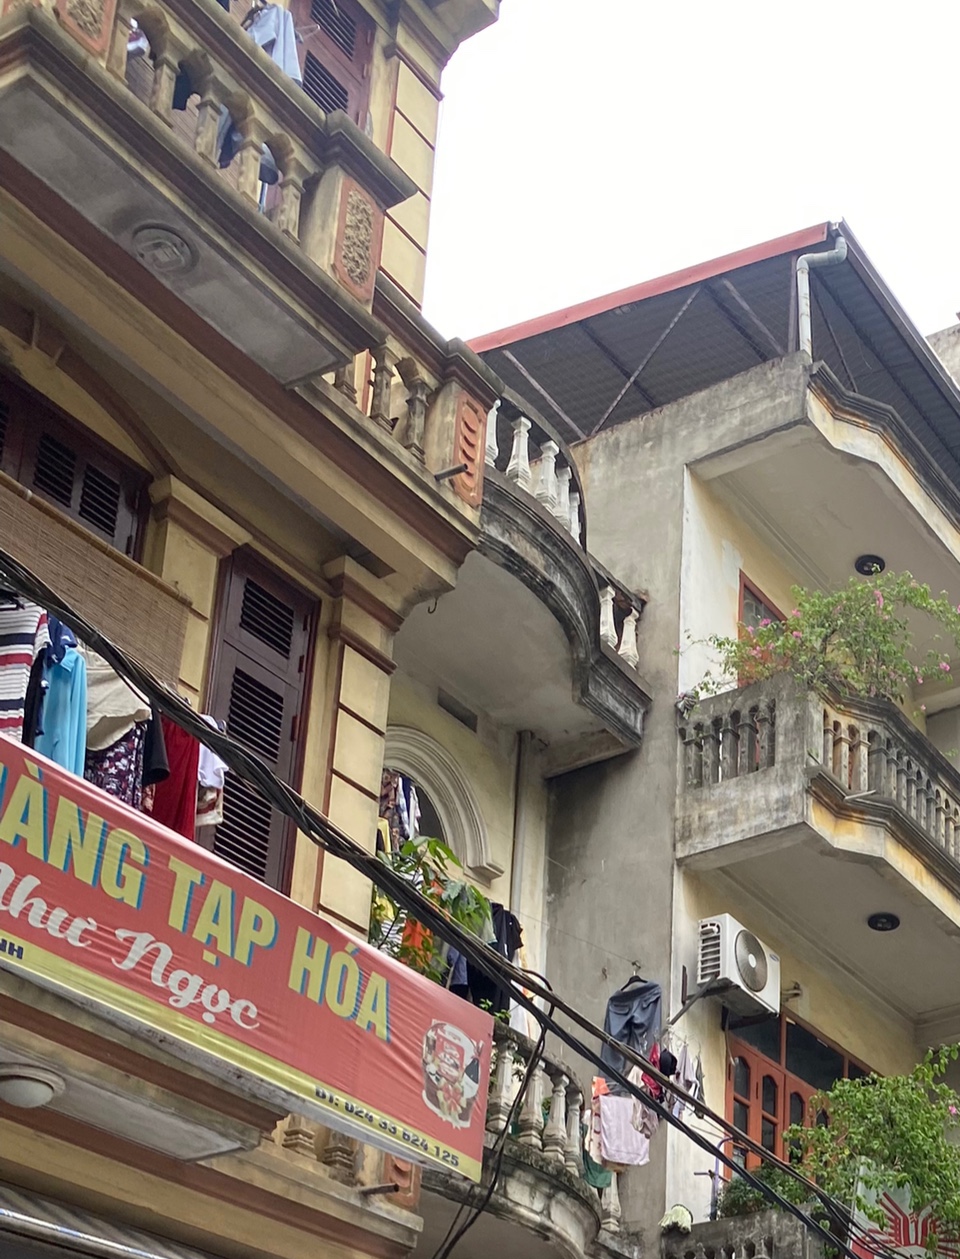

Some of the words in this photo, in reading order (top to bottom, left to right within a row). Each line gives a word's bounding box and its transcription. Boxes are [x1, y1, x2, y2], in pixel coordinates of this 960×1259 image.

[0, 757, 149, 911] ÀNG
[168, 855, 279, 967] TẠP
[288, 926, 391, 1042] HÓA
[111, 928, 260, 1030] Ngọc
[379, 1117, 397, 1136] 33
[434, 1145, 460, 1167] 125
